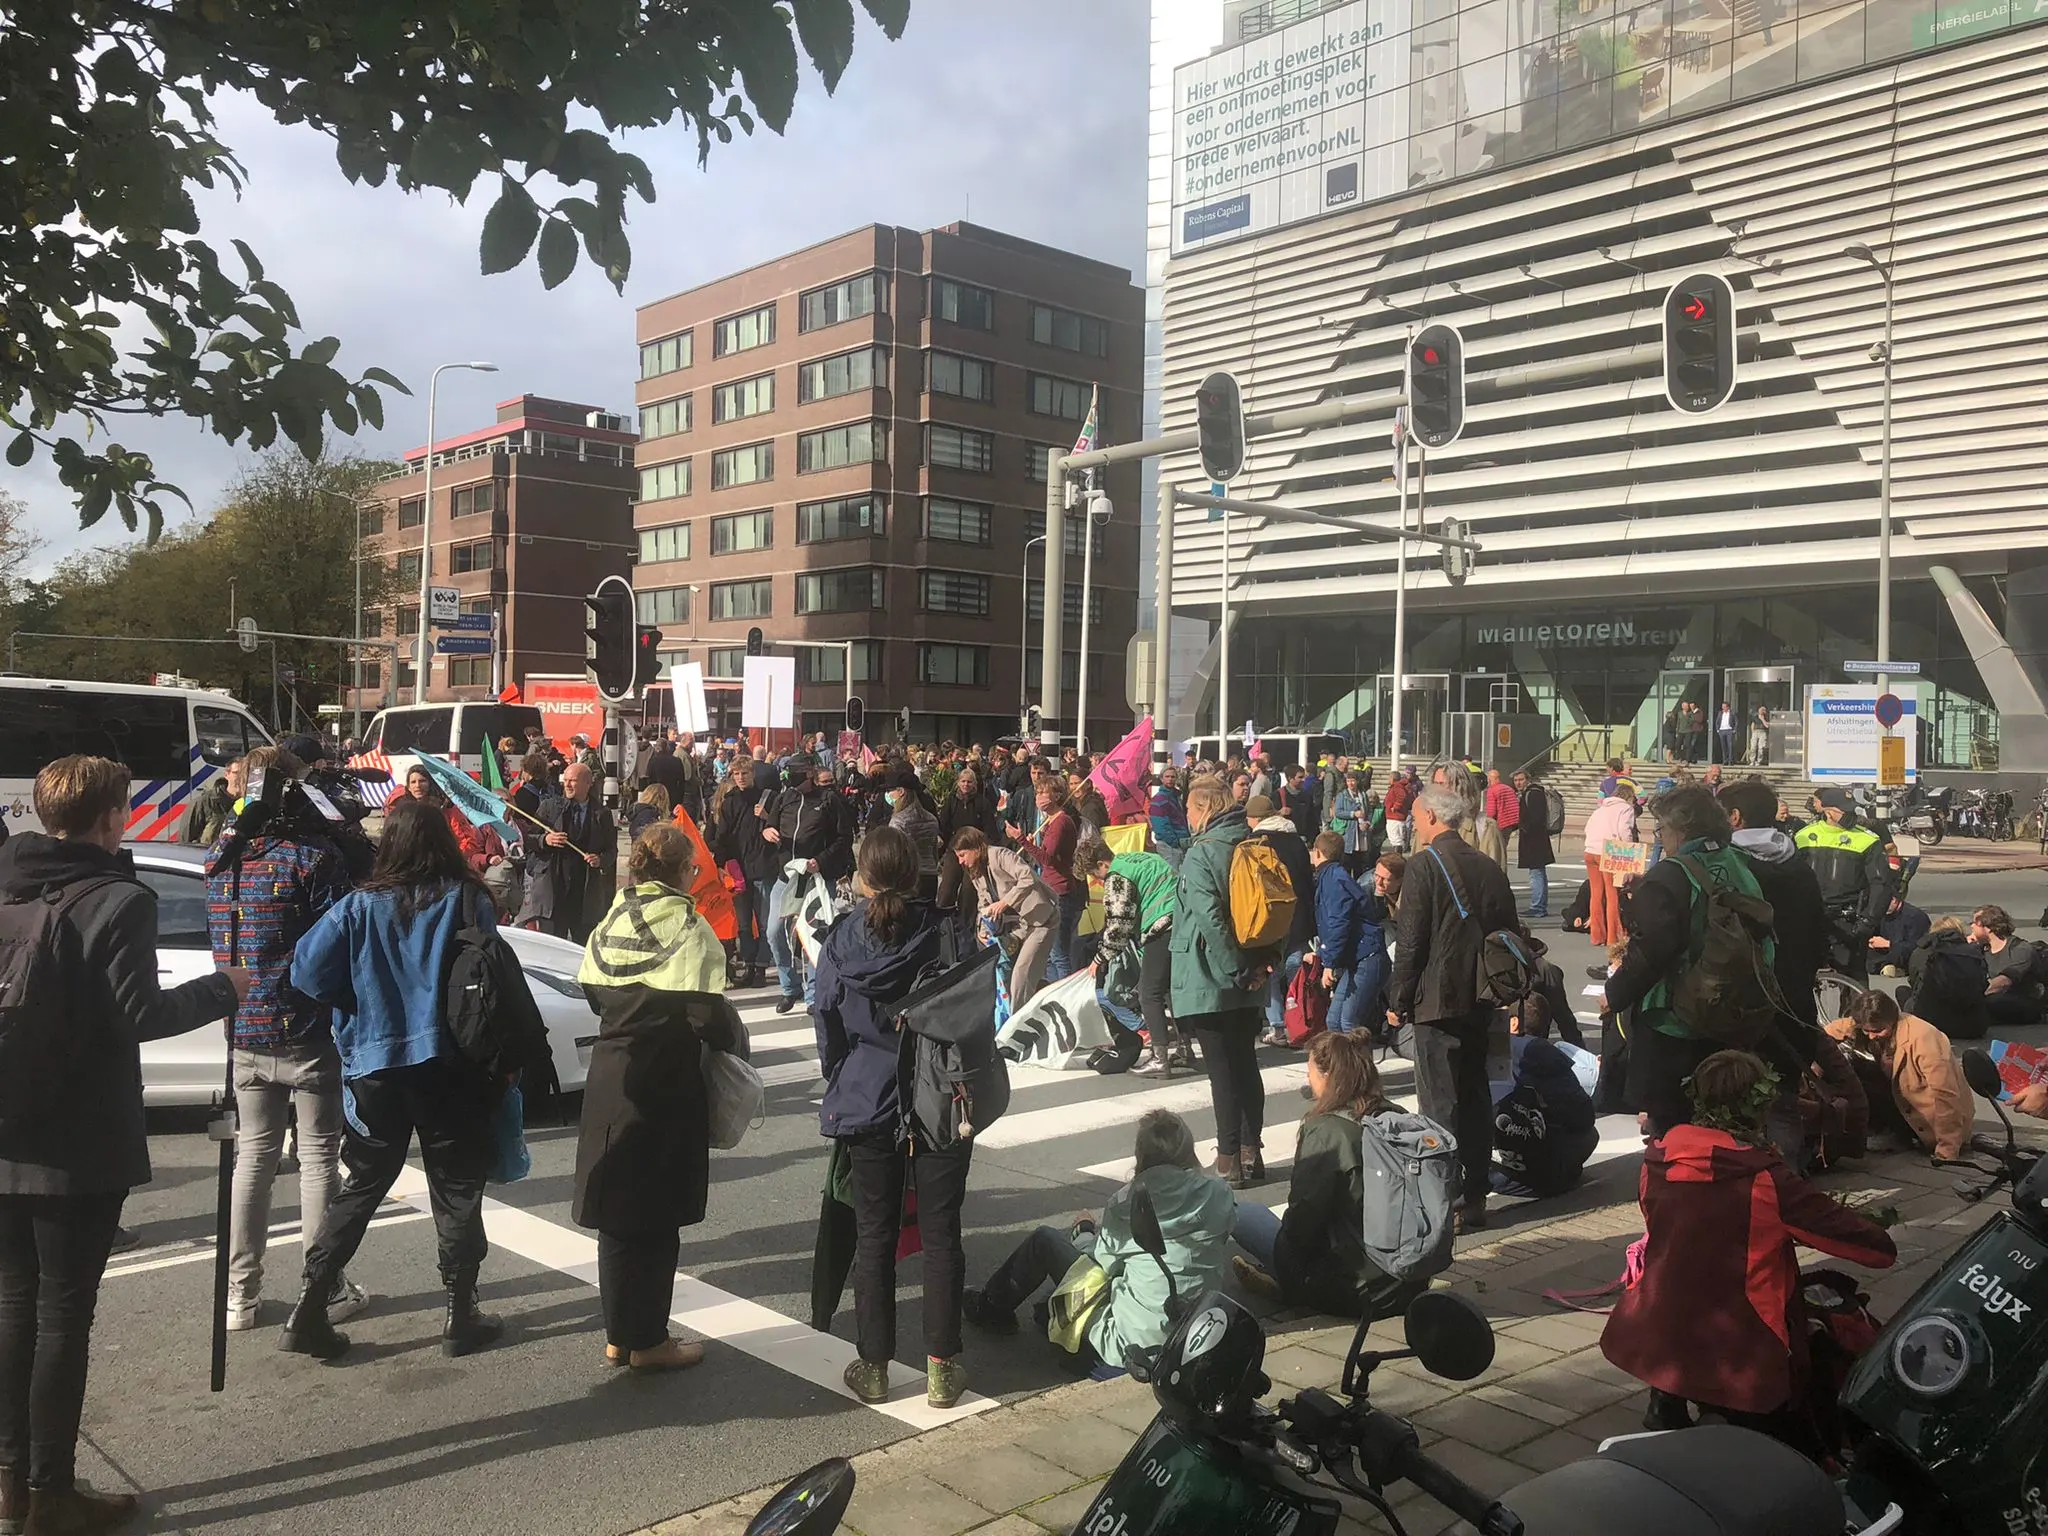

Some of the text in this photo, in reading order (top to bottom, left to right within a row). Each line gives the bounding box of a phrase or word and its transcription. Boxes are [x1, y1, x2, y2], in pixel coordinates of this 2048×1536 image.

[1930, 2, 2022, 33] ENERGIELABEL
[1186, 52, 1362, 126] een ontmoetingsplek
[1187, 22, 1382, 104] Hier wordt gewerkt aan
[1186, 74, 1376, 148] voor ondernemen voor
[1185, 119, 1310, 172] brede welvaart.
[1185, 126, 1361, 195] #ondernemenvoorNL
[1188, 211, 1216, 226] Rubens
[1216, 201, 1244, 218] Capital
[1328, 190, 1355, 204] HEVO
[1827, 703, 1876, 711] Verkeershin
[1958, 1263, 2031, 1323] felyx
[1085, 1497, 1129, 1536] fel
